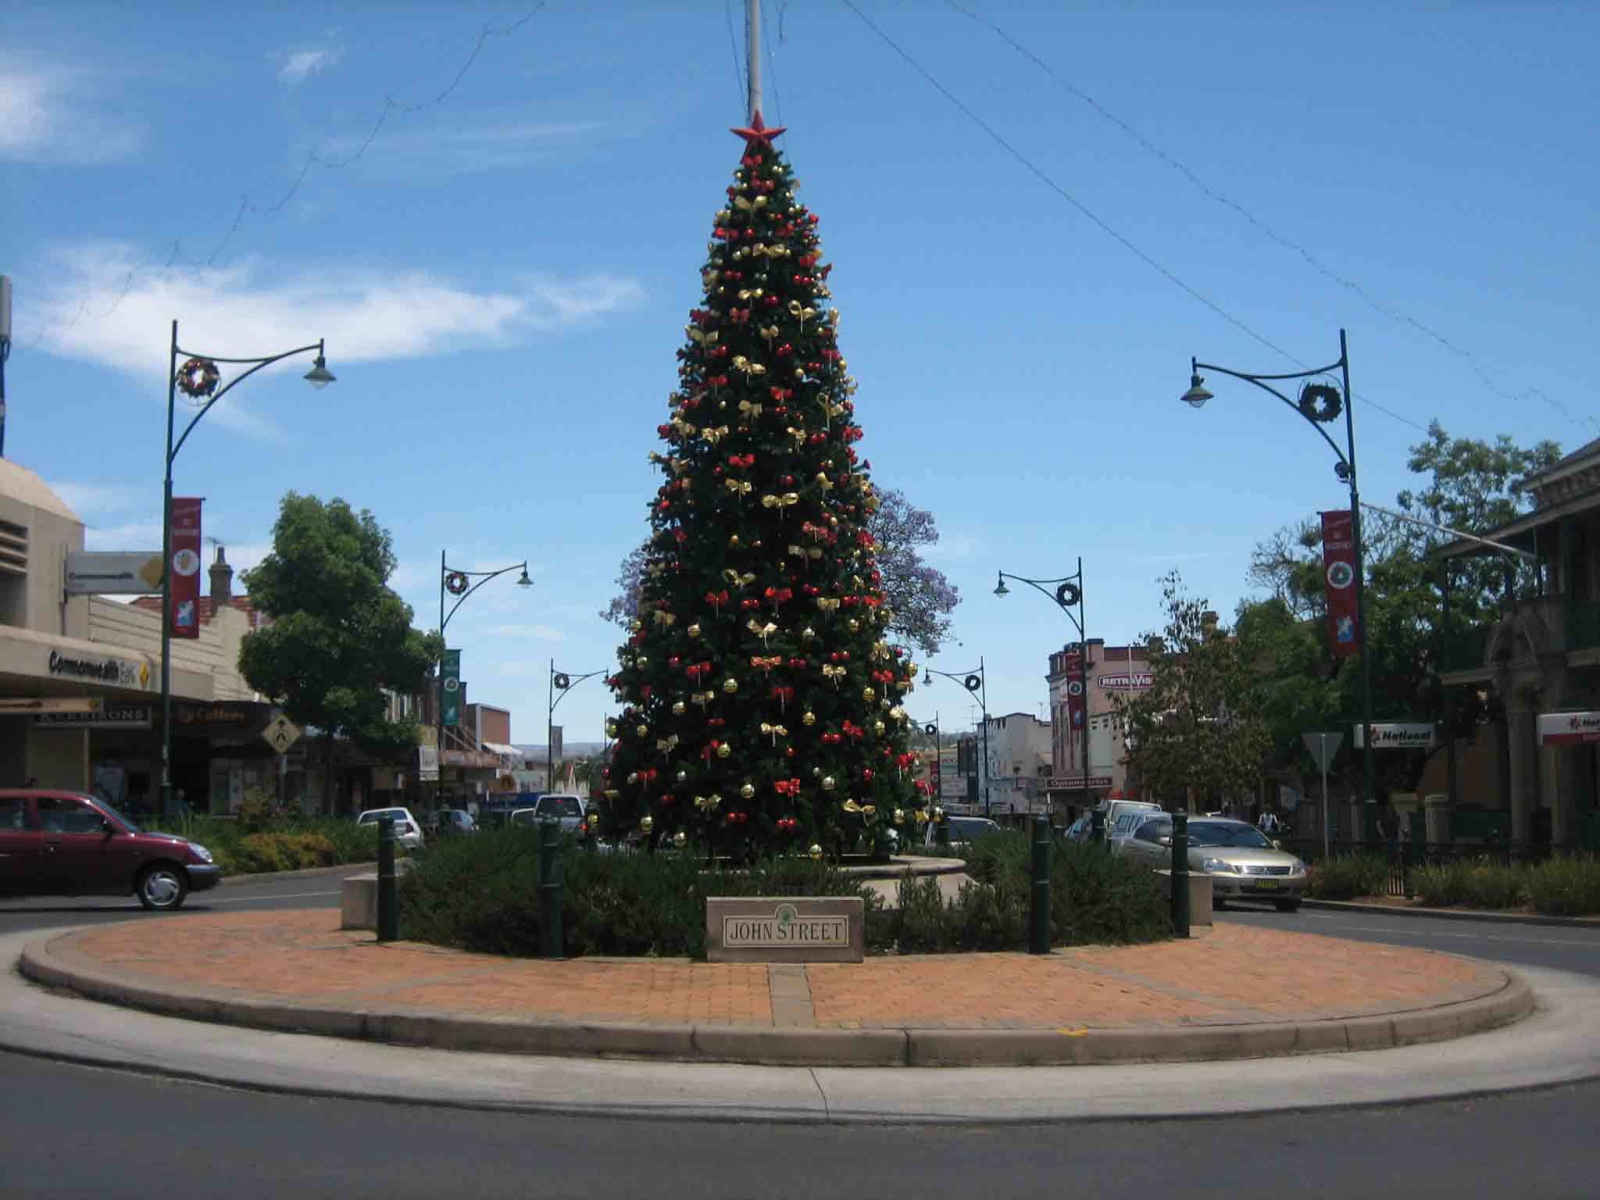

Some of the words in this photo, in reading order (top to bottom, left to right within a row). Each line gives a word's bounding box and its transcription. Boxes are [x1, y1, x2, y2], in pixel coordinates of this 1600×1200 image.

[49, 649, 119, 680] Commonwealth
[1382, 730, 1432, 741] National
[730, 923, 772, 940] JOHN
[777, 923, 842, 940] STREET
